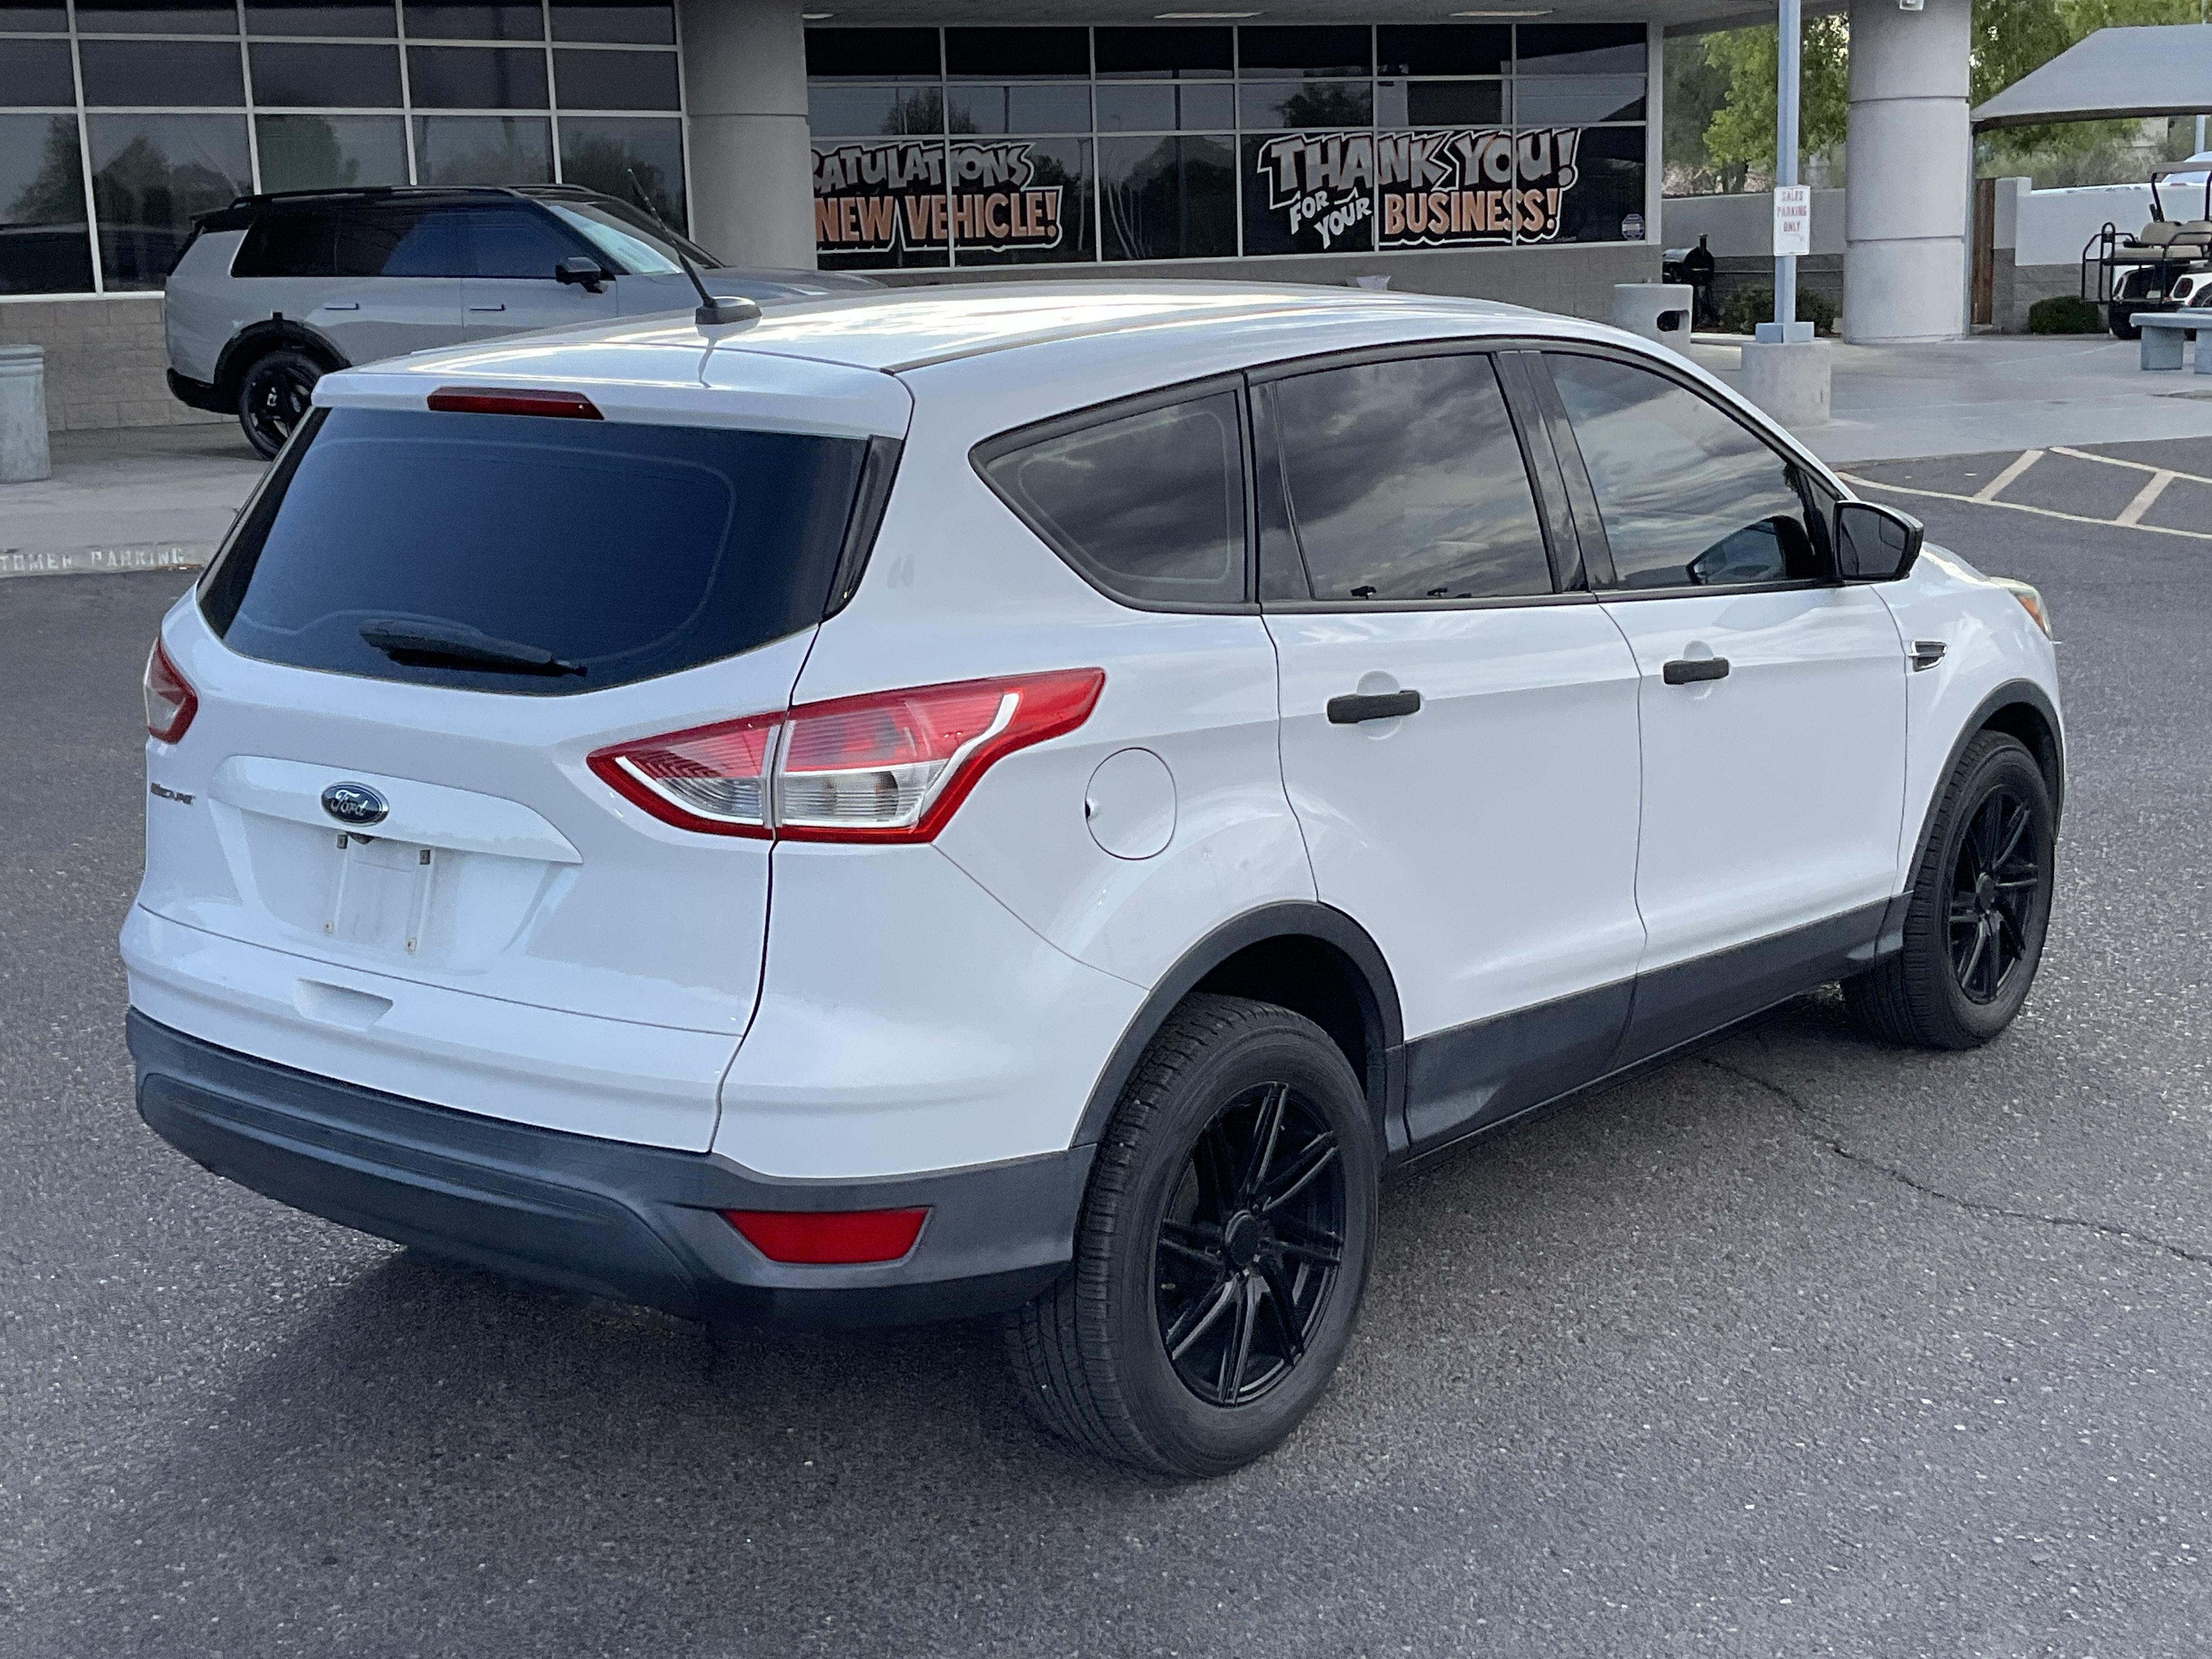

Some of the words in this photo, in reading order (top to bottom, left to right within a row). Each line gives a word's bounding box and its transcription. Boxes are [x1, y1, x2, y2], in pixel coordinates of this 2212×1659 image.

[1271, 136, 1446, 192] THANK
[1454, 130, 1576, 187] YOU!
[1290, 191, 1330, 234] FOR
[1385, 188, 1559, 234] BUSINESS!
[1777, 205, 1807, 217] PARKING
[1781, 190, 1803, 201] SALES
[815, 195, 894, 242] NEW
[905, 191, 1057, 240] VEHICLE!
[1314, 198, 1372, 249] YOUR
[1784, 221, 1801, 232] ONLY
[91, 549, 184, 567] PARKING
[330, 789, 368, 816] Ford
